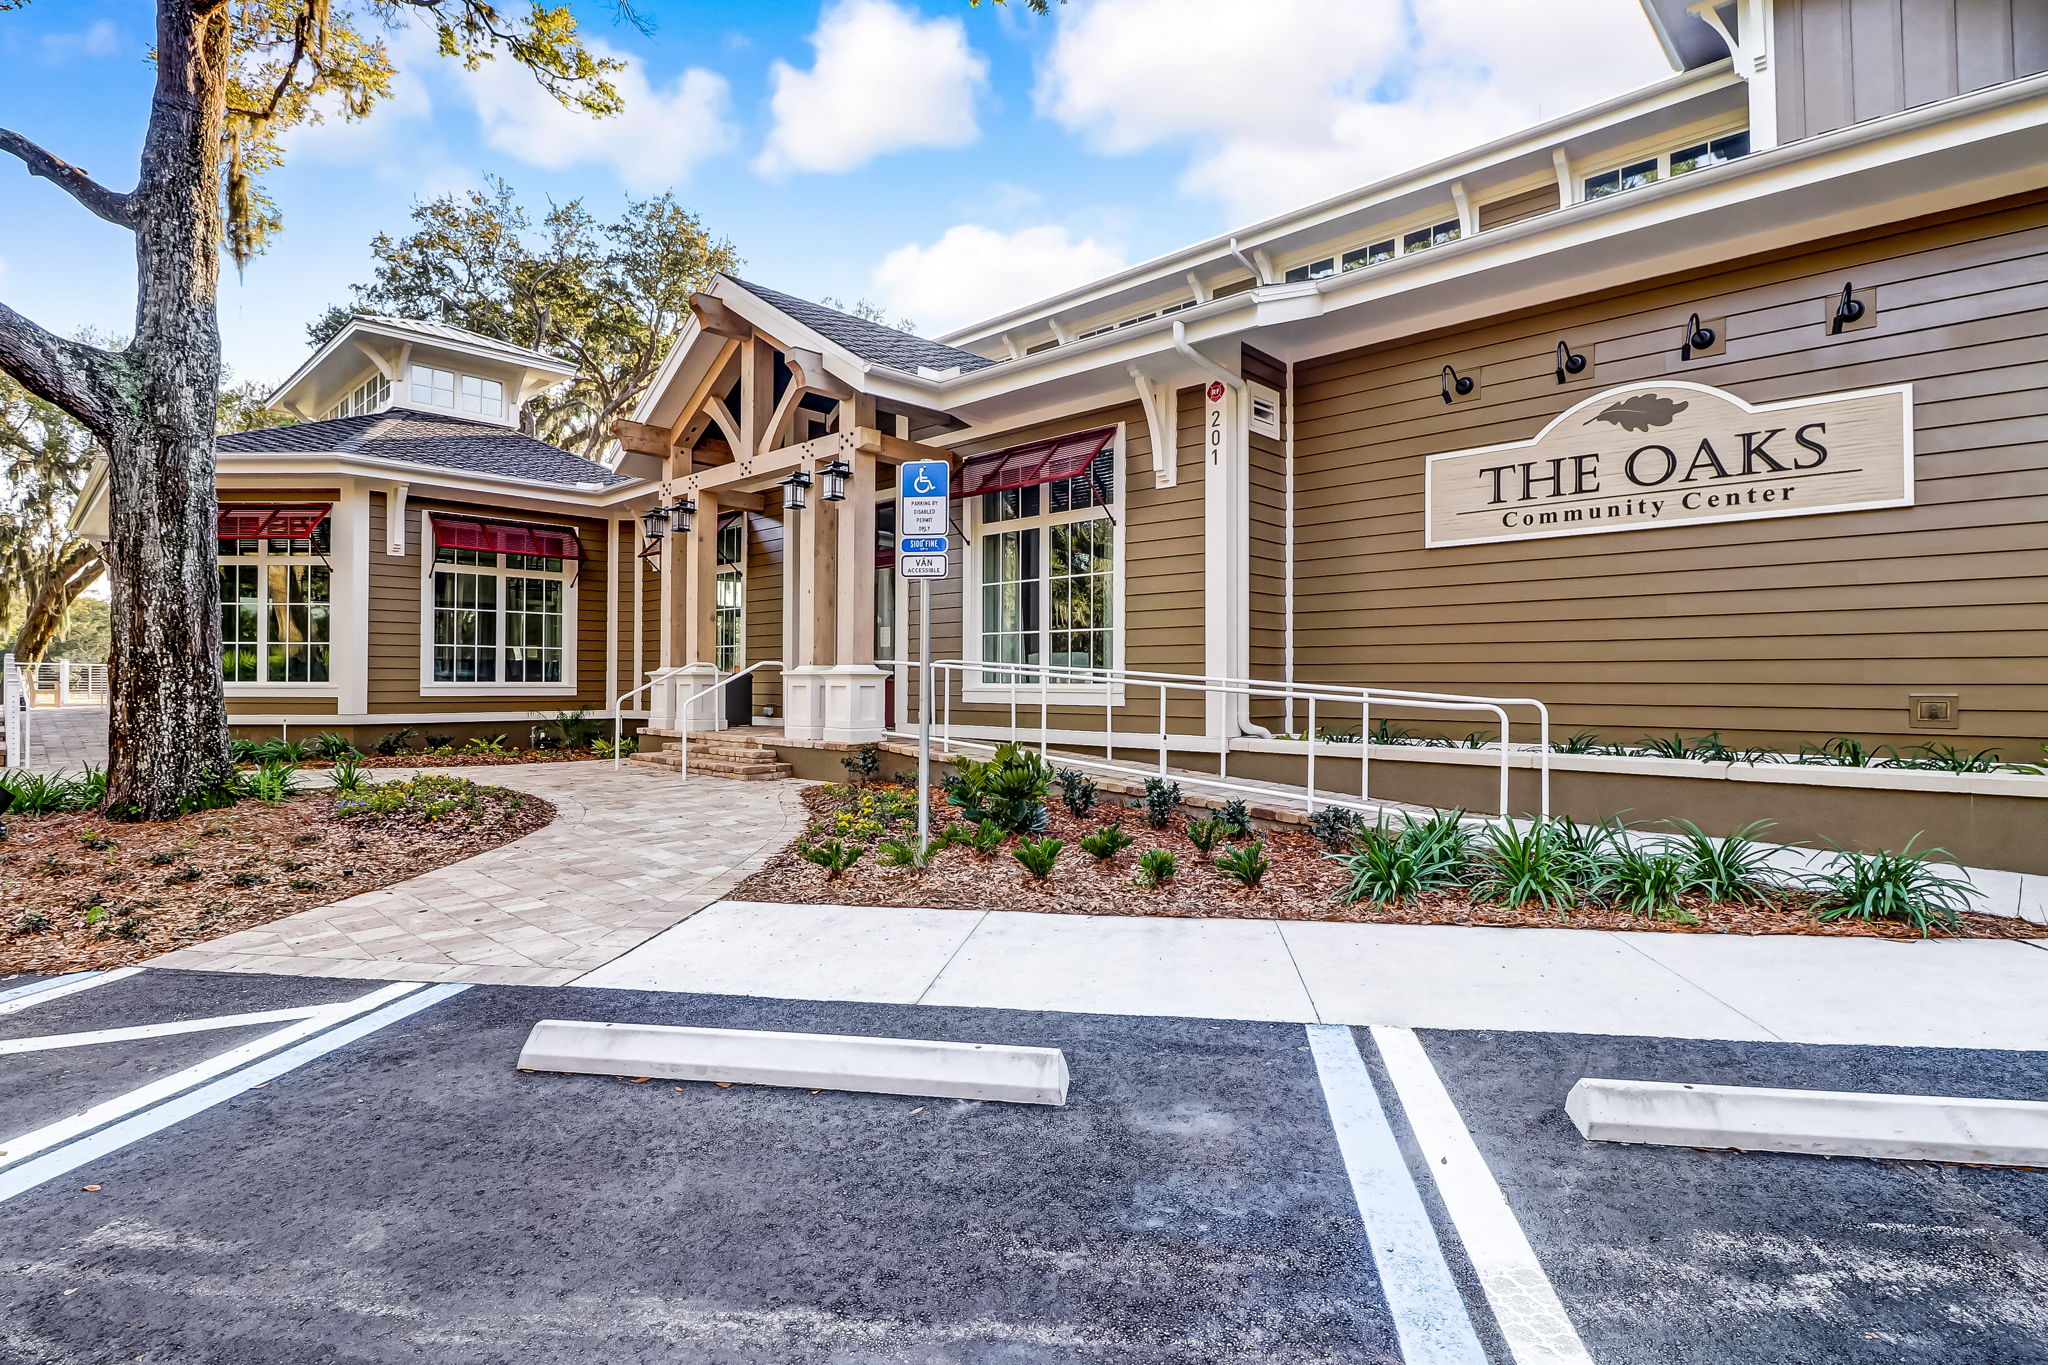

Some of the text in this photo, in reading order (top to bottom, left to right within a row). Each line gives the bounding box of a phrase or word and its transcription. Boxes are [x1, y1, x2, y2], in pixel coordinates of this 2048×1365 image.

[1211, 410, 1221, 466] 201
[1478, 422, 1828, 505] THE OAKS
[1502, 486, 1796, 528] Community Center
[915, 559, 933, 567] VAN
[925, 540, 939, 548] FINE
